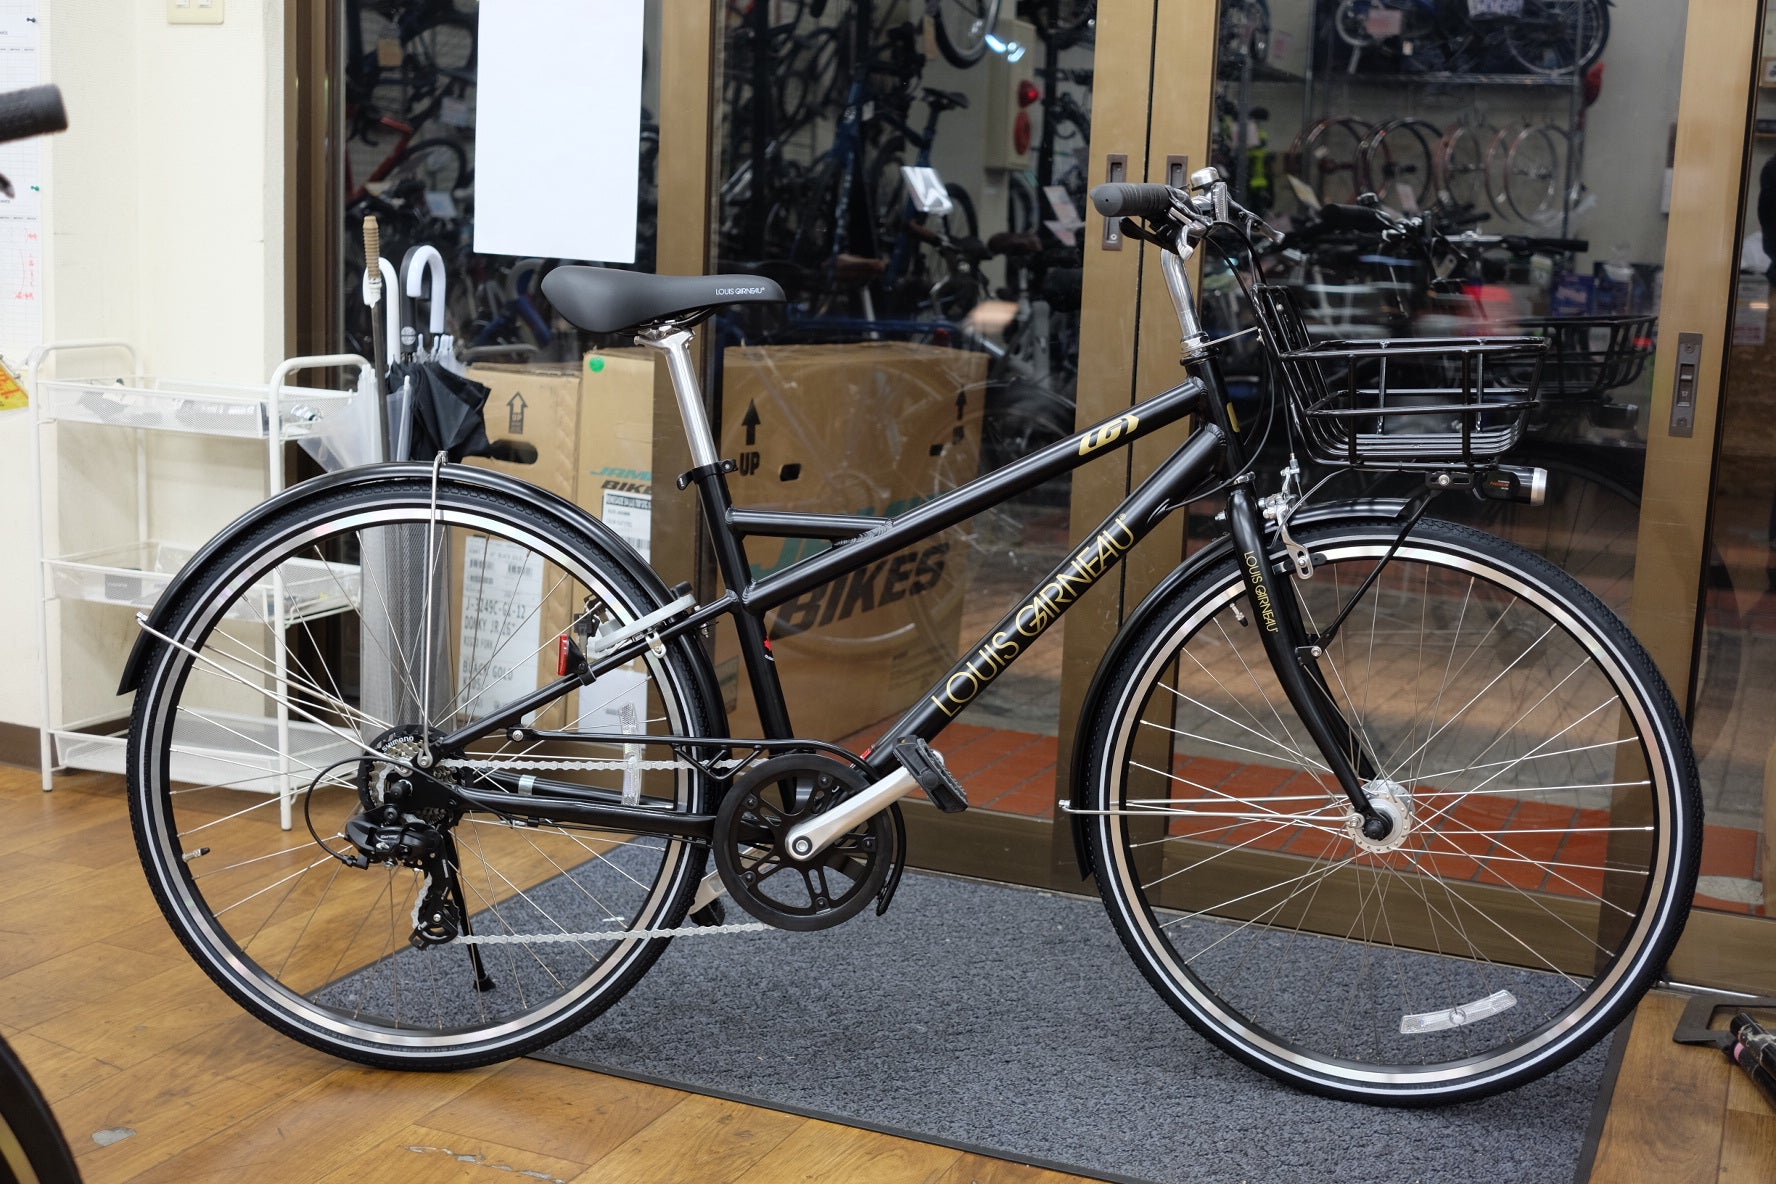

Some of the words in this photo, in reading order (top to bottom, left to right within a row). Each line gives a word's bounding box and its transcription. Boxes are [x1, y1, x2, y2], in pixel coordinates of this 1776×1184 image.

[715, 288, 734, 296] LOUIS
[740, 451, 760, 476] UP
[1244, 550, 1263, 584] LOUIS
[769, 542, 949, 641] BIKES
[931, 631, 1020, 717] LOUIS
